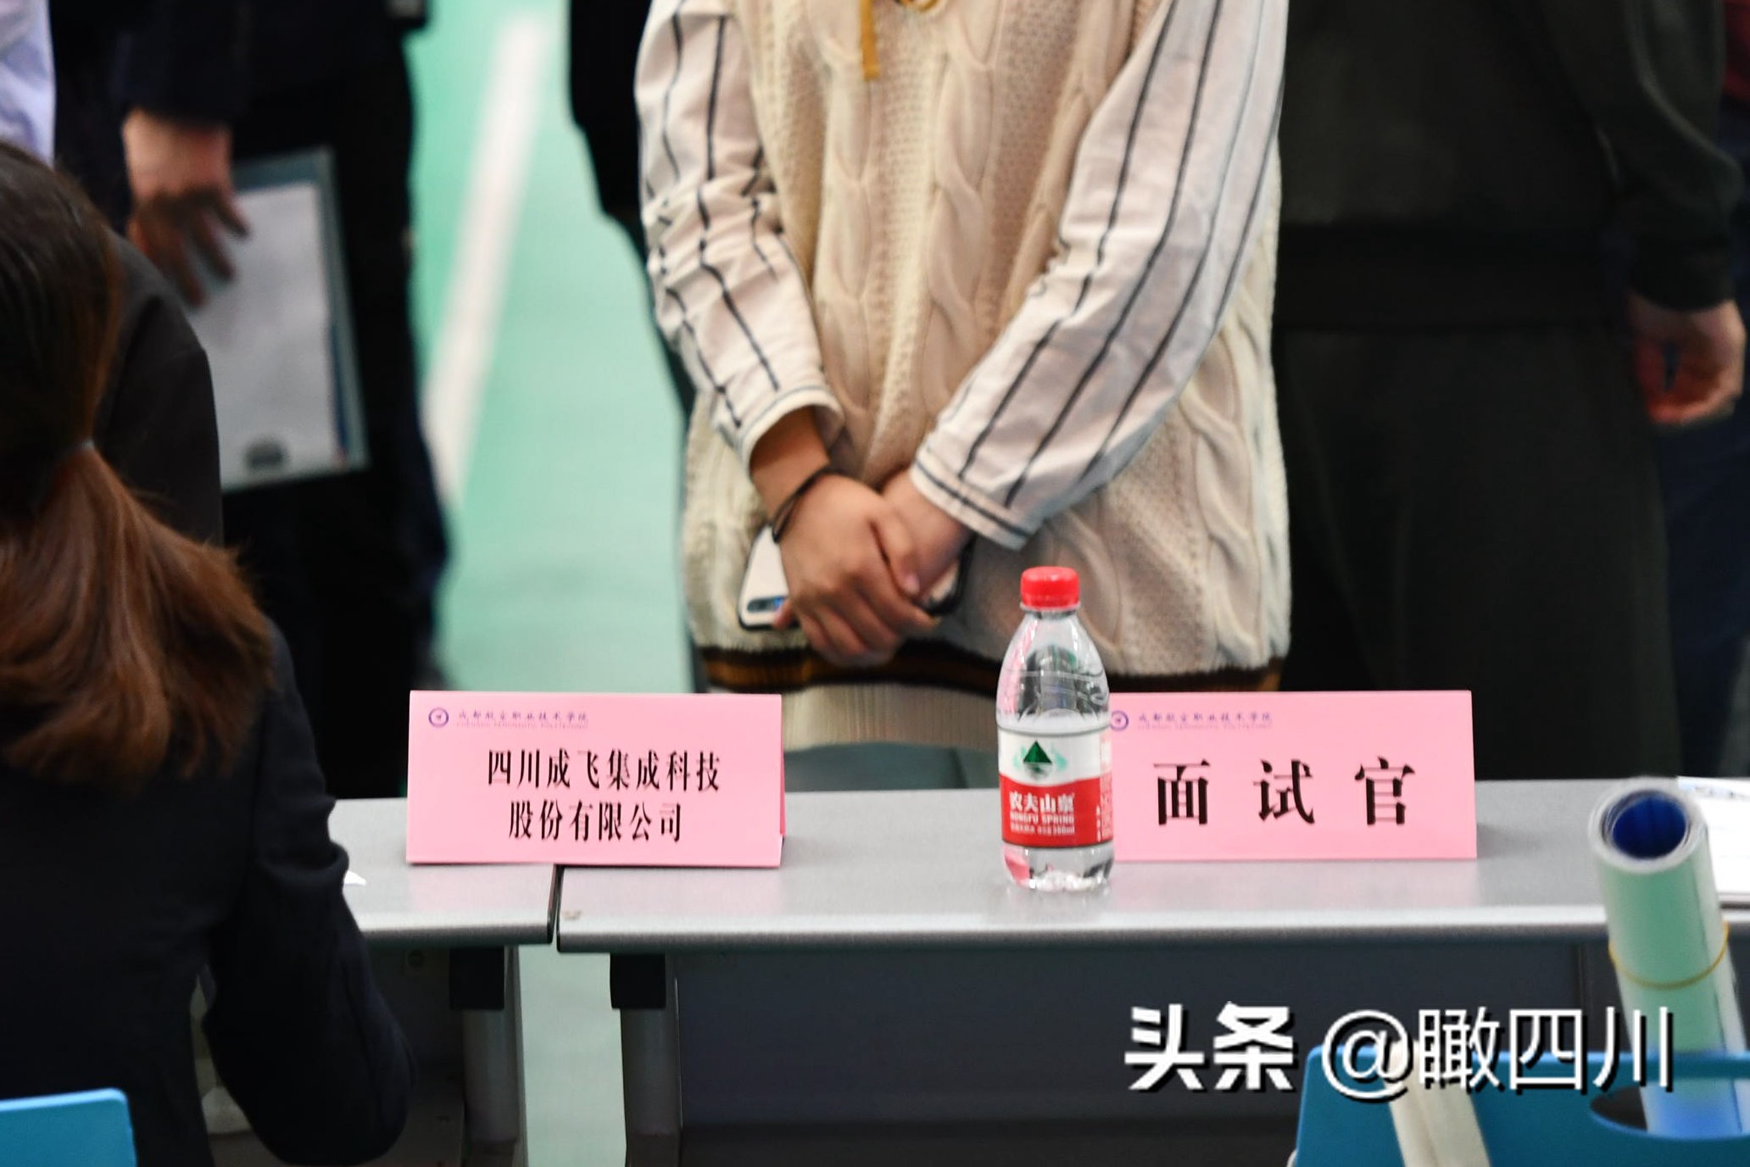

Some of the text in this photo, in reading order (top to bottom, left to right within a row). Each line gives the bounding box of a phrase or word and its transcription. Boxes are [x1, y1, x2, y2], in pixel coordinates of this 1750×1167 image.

[488, 748, 721, 793] 四川成飞集成科技
[1153, 756, 1416, 826] 面试官
[508, 799, 683, 844] 股份有限公司
[1010, 791, 1074, 814] 农夫山泉
